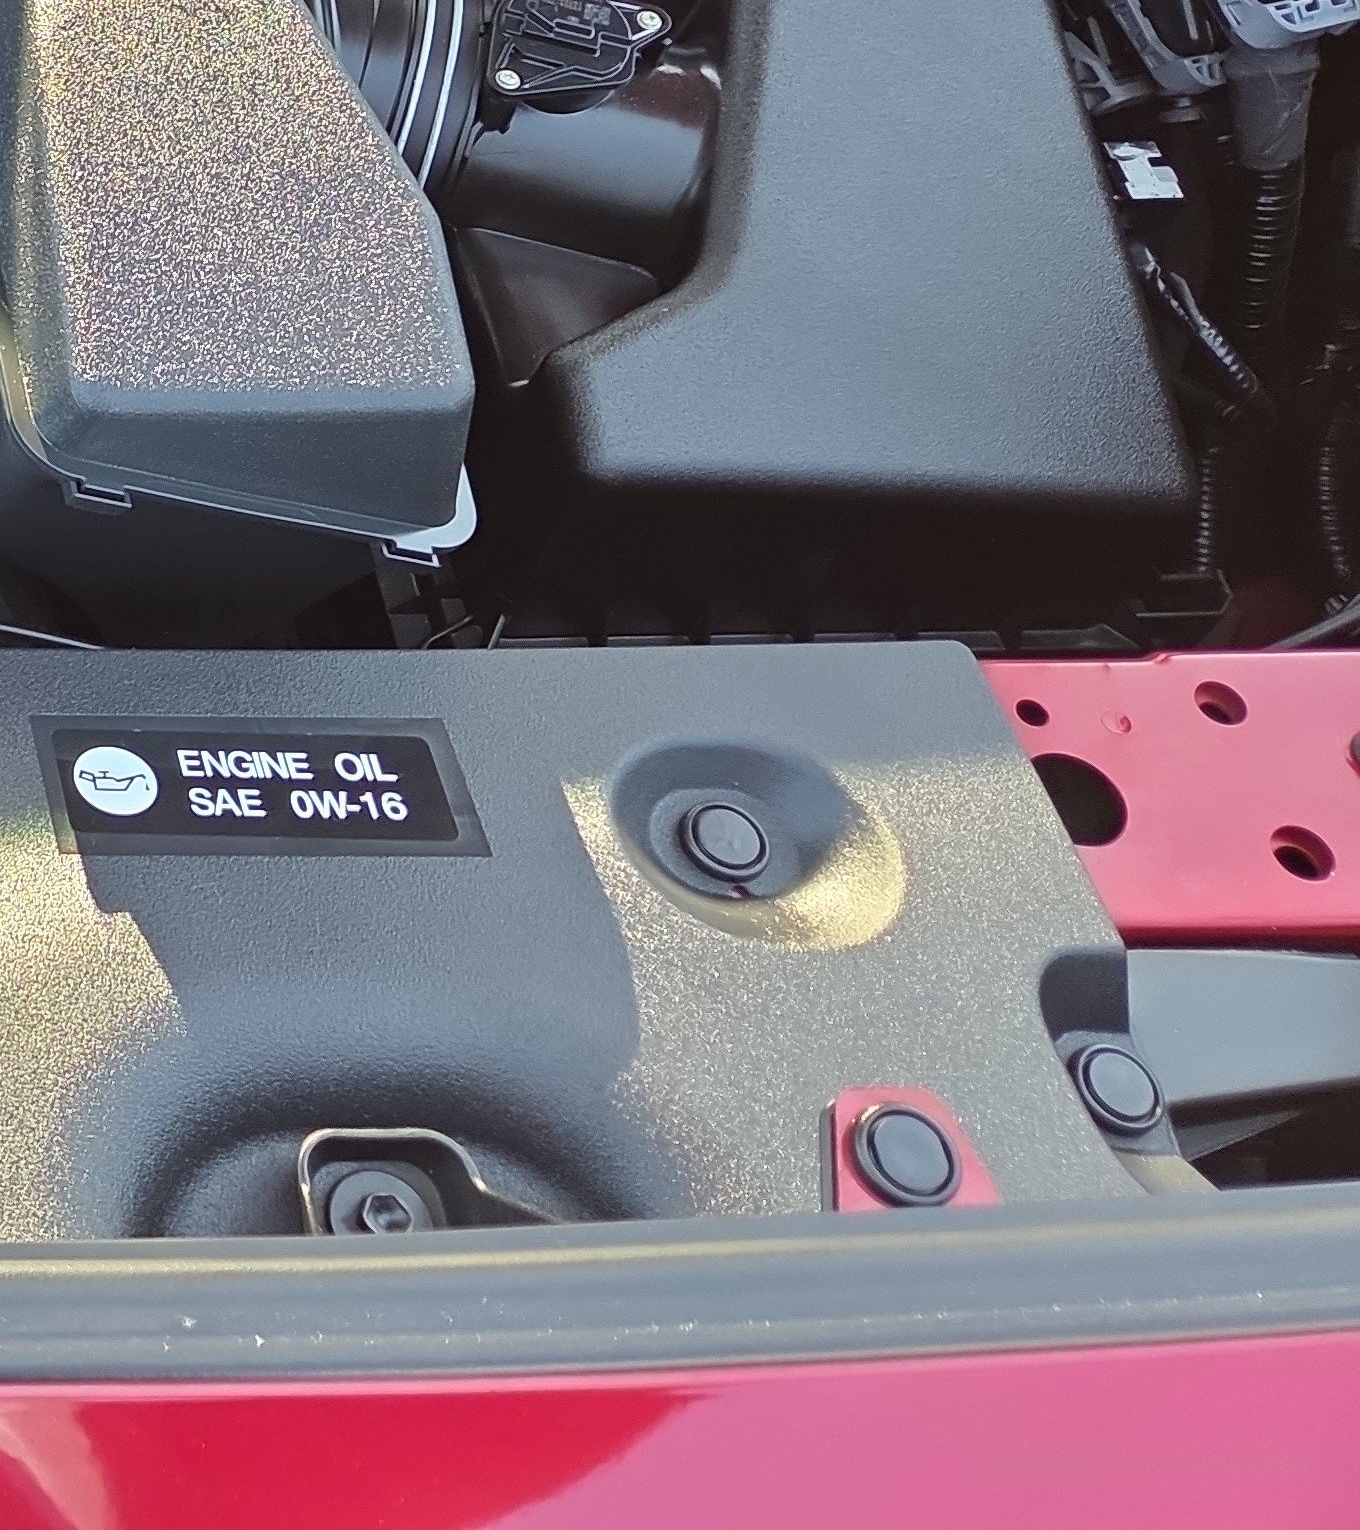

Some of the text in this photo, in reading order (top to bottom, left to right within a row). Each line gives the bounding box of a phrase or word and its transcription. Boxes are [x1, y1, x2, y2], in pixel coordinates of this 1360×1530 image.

[176, 749, 399, 783] ENGINE OIL
[188, 787, 409, 822] SAE 0W-16
